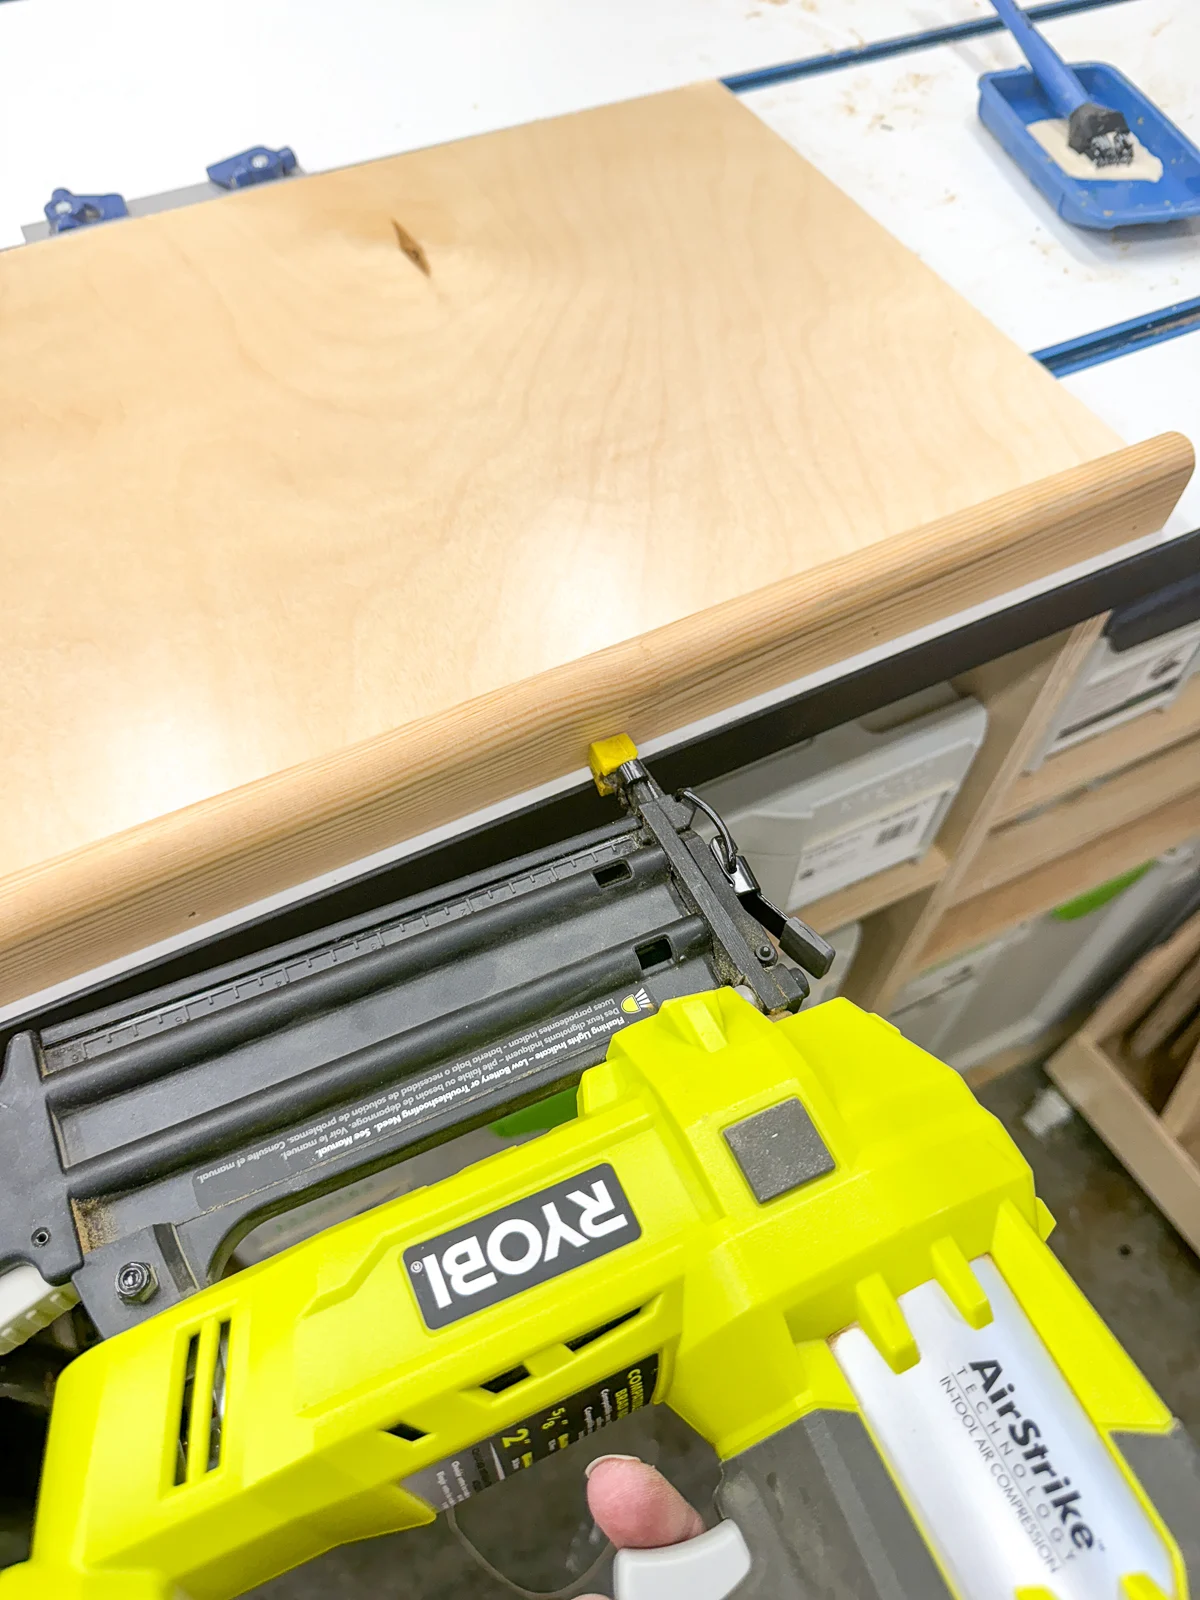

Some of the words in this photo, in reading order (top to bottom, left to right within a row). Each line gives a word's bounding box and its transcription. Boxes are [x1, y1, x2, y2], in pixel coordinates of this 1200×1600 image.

[592, 997, 614, 1012] Luces
[603, 1006, 619, 1018] Des
[537, 1005, 593, 1036] parpadeantes
[586, 1013, 604, 1026] feux
[590, 1014, 624, 1036] Flashing
[508, 1030, 538, 1049] indican
[566, 1029, 591, 1046] Lights
[471, 1046, 503, 1065] batería
[503, 1039, 544, 1062] indiquent
[534, 1041, 567, 1060] Indicate
[450, 1058, 471, 1074] baja
[481, 1059, 499, 1072] pile
[510, 1058, 528, 1071] Low
[399, 1071, 444, 1096] necesidad
[443, 1077, 456, 1087] ou
[456, 1066, 482, 1083] faible
[469, 1079, 480, 1088] or
[479, 1066, 511, 1085] Battery
[386, 1090, 400, 1102] de
[400, 1082, 470, 1120] Troubleshooting
[401, 1096, 415, 1107] de
[414, 1083, 444, 1101] besoin
[347, 1100, 402, 1131] dépannage.
[350, 1096, 387, 1118] solución
[337, 1112, 351, 1123] de
[372, 1114, 401, 1132] Need.
[285, 1116, 338, 1145] problemas.
[318, 1133, 328, 1144] le
[327, 1125, 348, 1140] Voir
[352, 1127, 371, 1141] See
[246, 1139, 286, 1163] Consulte
[279, 1138, 318, 1161] manuel.
[313, 1135, 353, 1158] Manual.
[235, 1156, 246, 1167] el
[195, 1161, 236, 1184] manual.
[412, 1179, 629, 1310] RYOBI
[956, 1365, 1076, 1562] TECHNOLOGY
[968, 1359, 1095, 1551] AirStrike
[939, 1375, 980, 1438] IN-TOOL
[974, 1437, 995, 1463] AIR
[989, 1462, 1061, 1574] COMPRESSION
